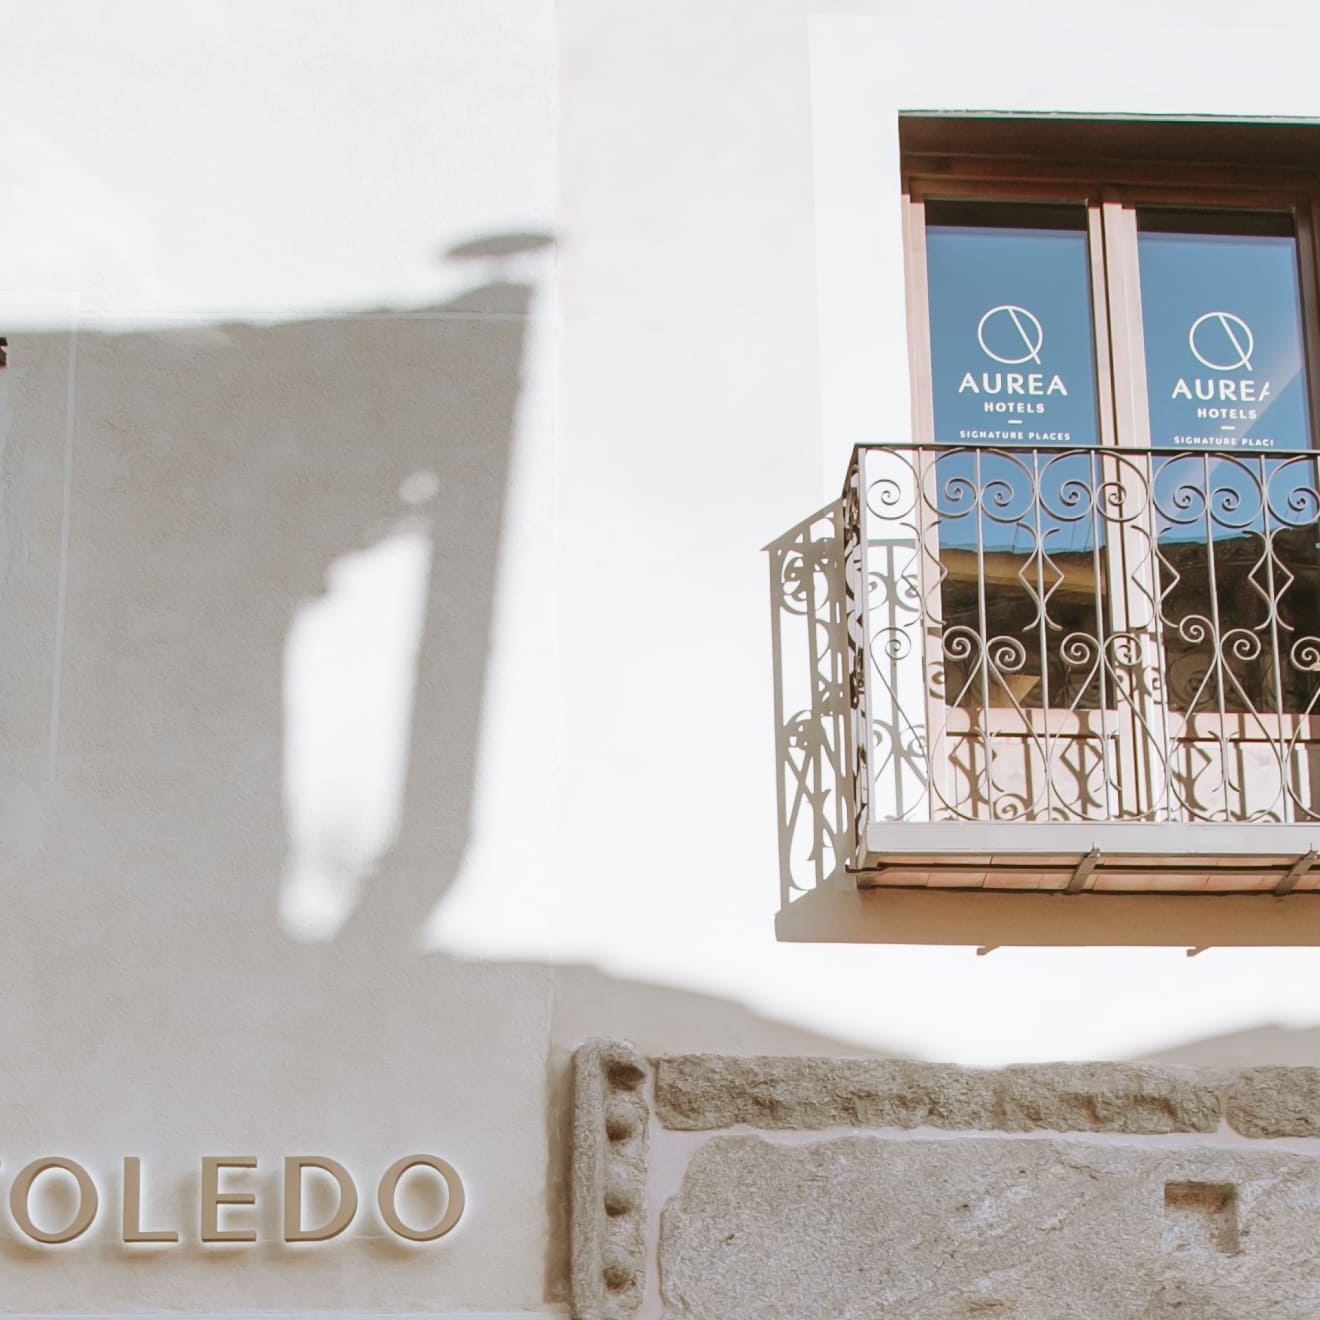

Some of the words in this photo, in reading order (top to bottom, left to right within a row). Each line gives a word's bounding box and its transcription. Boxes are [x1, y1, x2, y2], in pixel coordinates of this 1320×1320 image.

[959, 373, 1068, 397] AUREA
[984, 401, 1045, 414] HOTELS
[1197, 408, 1257, 420] HOTELS
[959, 430, 1024, 440] SIGNATURE
[1028, 432, 1071, 441] PLACES
[1173, 436, 1237, 446] SIGNATURE
